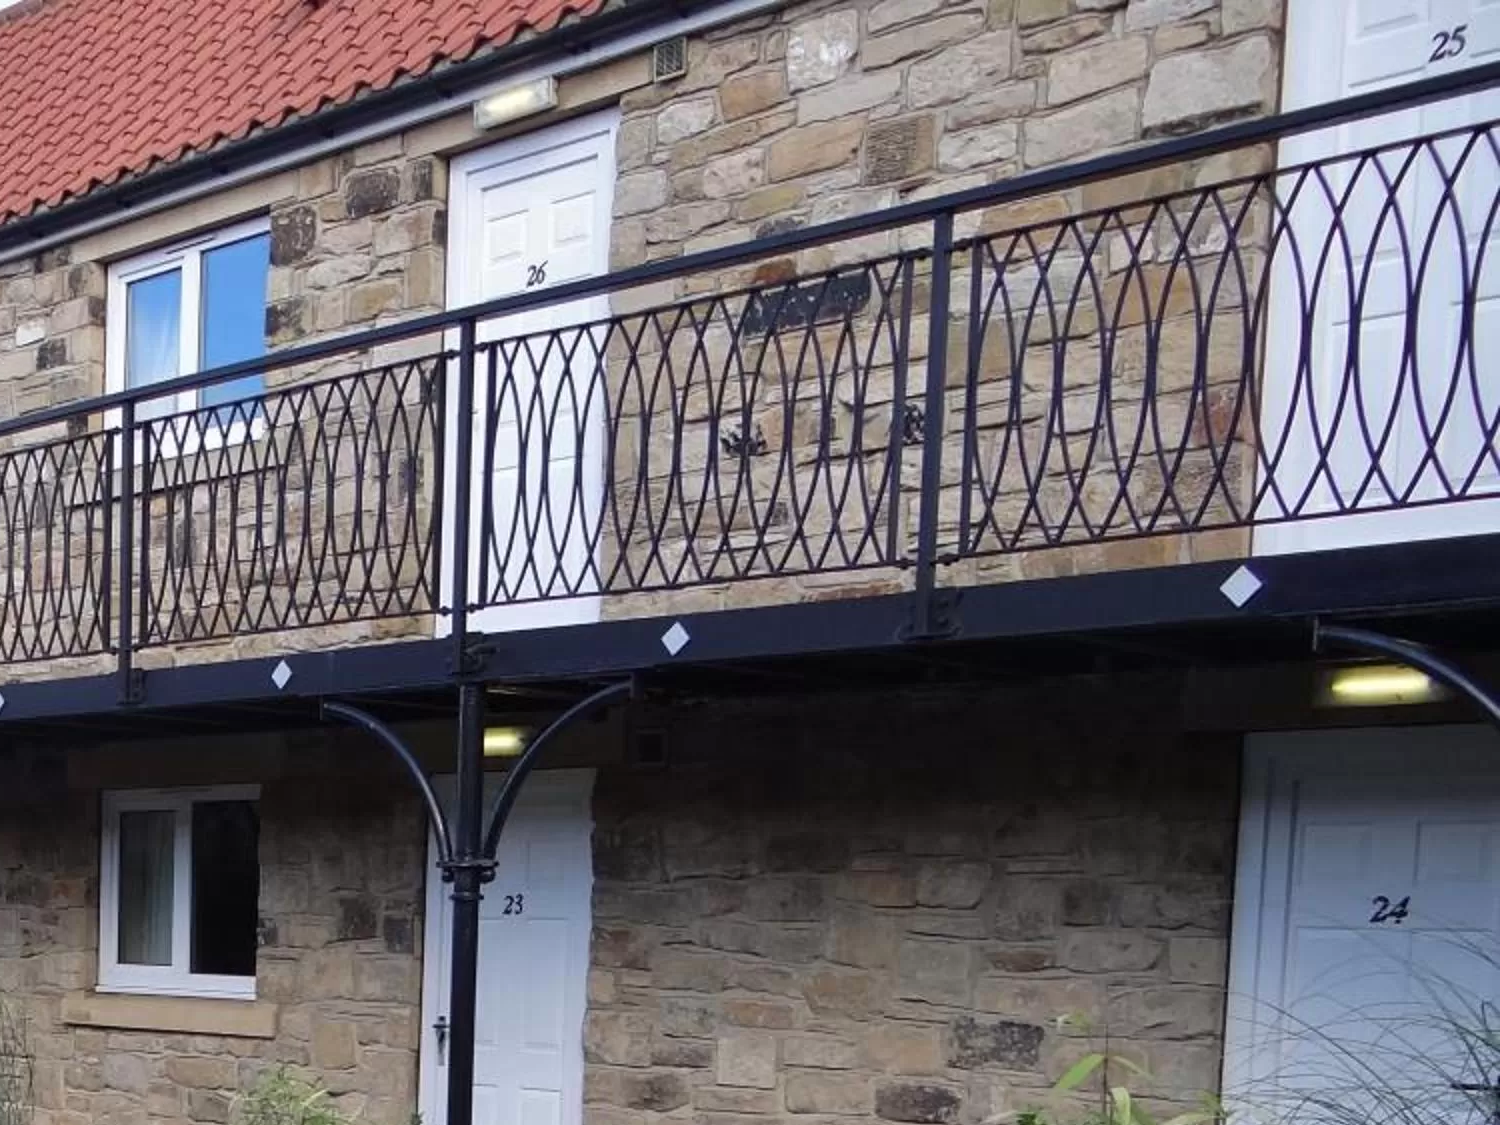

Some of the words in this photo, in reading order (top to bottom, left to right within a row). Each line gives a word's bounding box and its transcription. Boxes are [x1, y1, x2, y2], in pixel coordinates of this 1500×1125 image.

[1428, 23, 1468, 63] 25
[526, 260, 548, 288] 26
[501, 894, 523, 915] 23
[1369, 896, 1410, 924] 24
